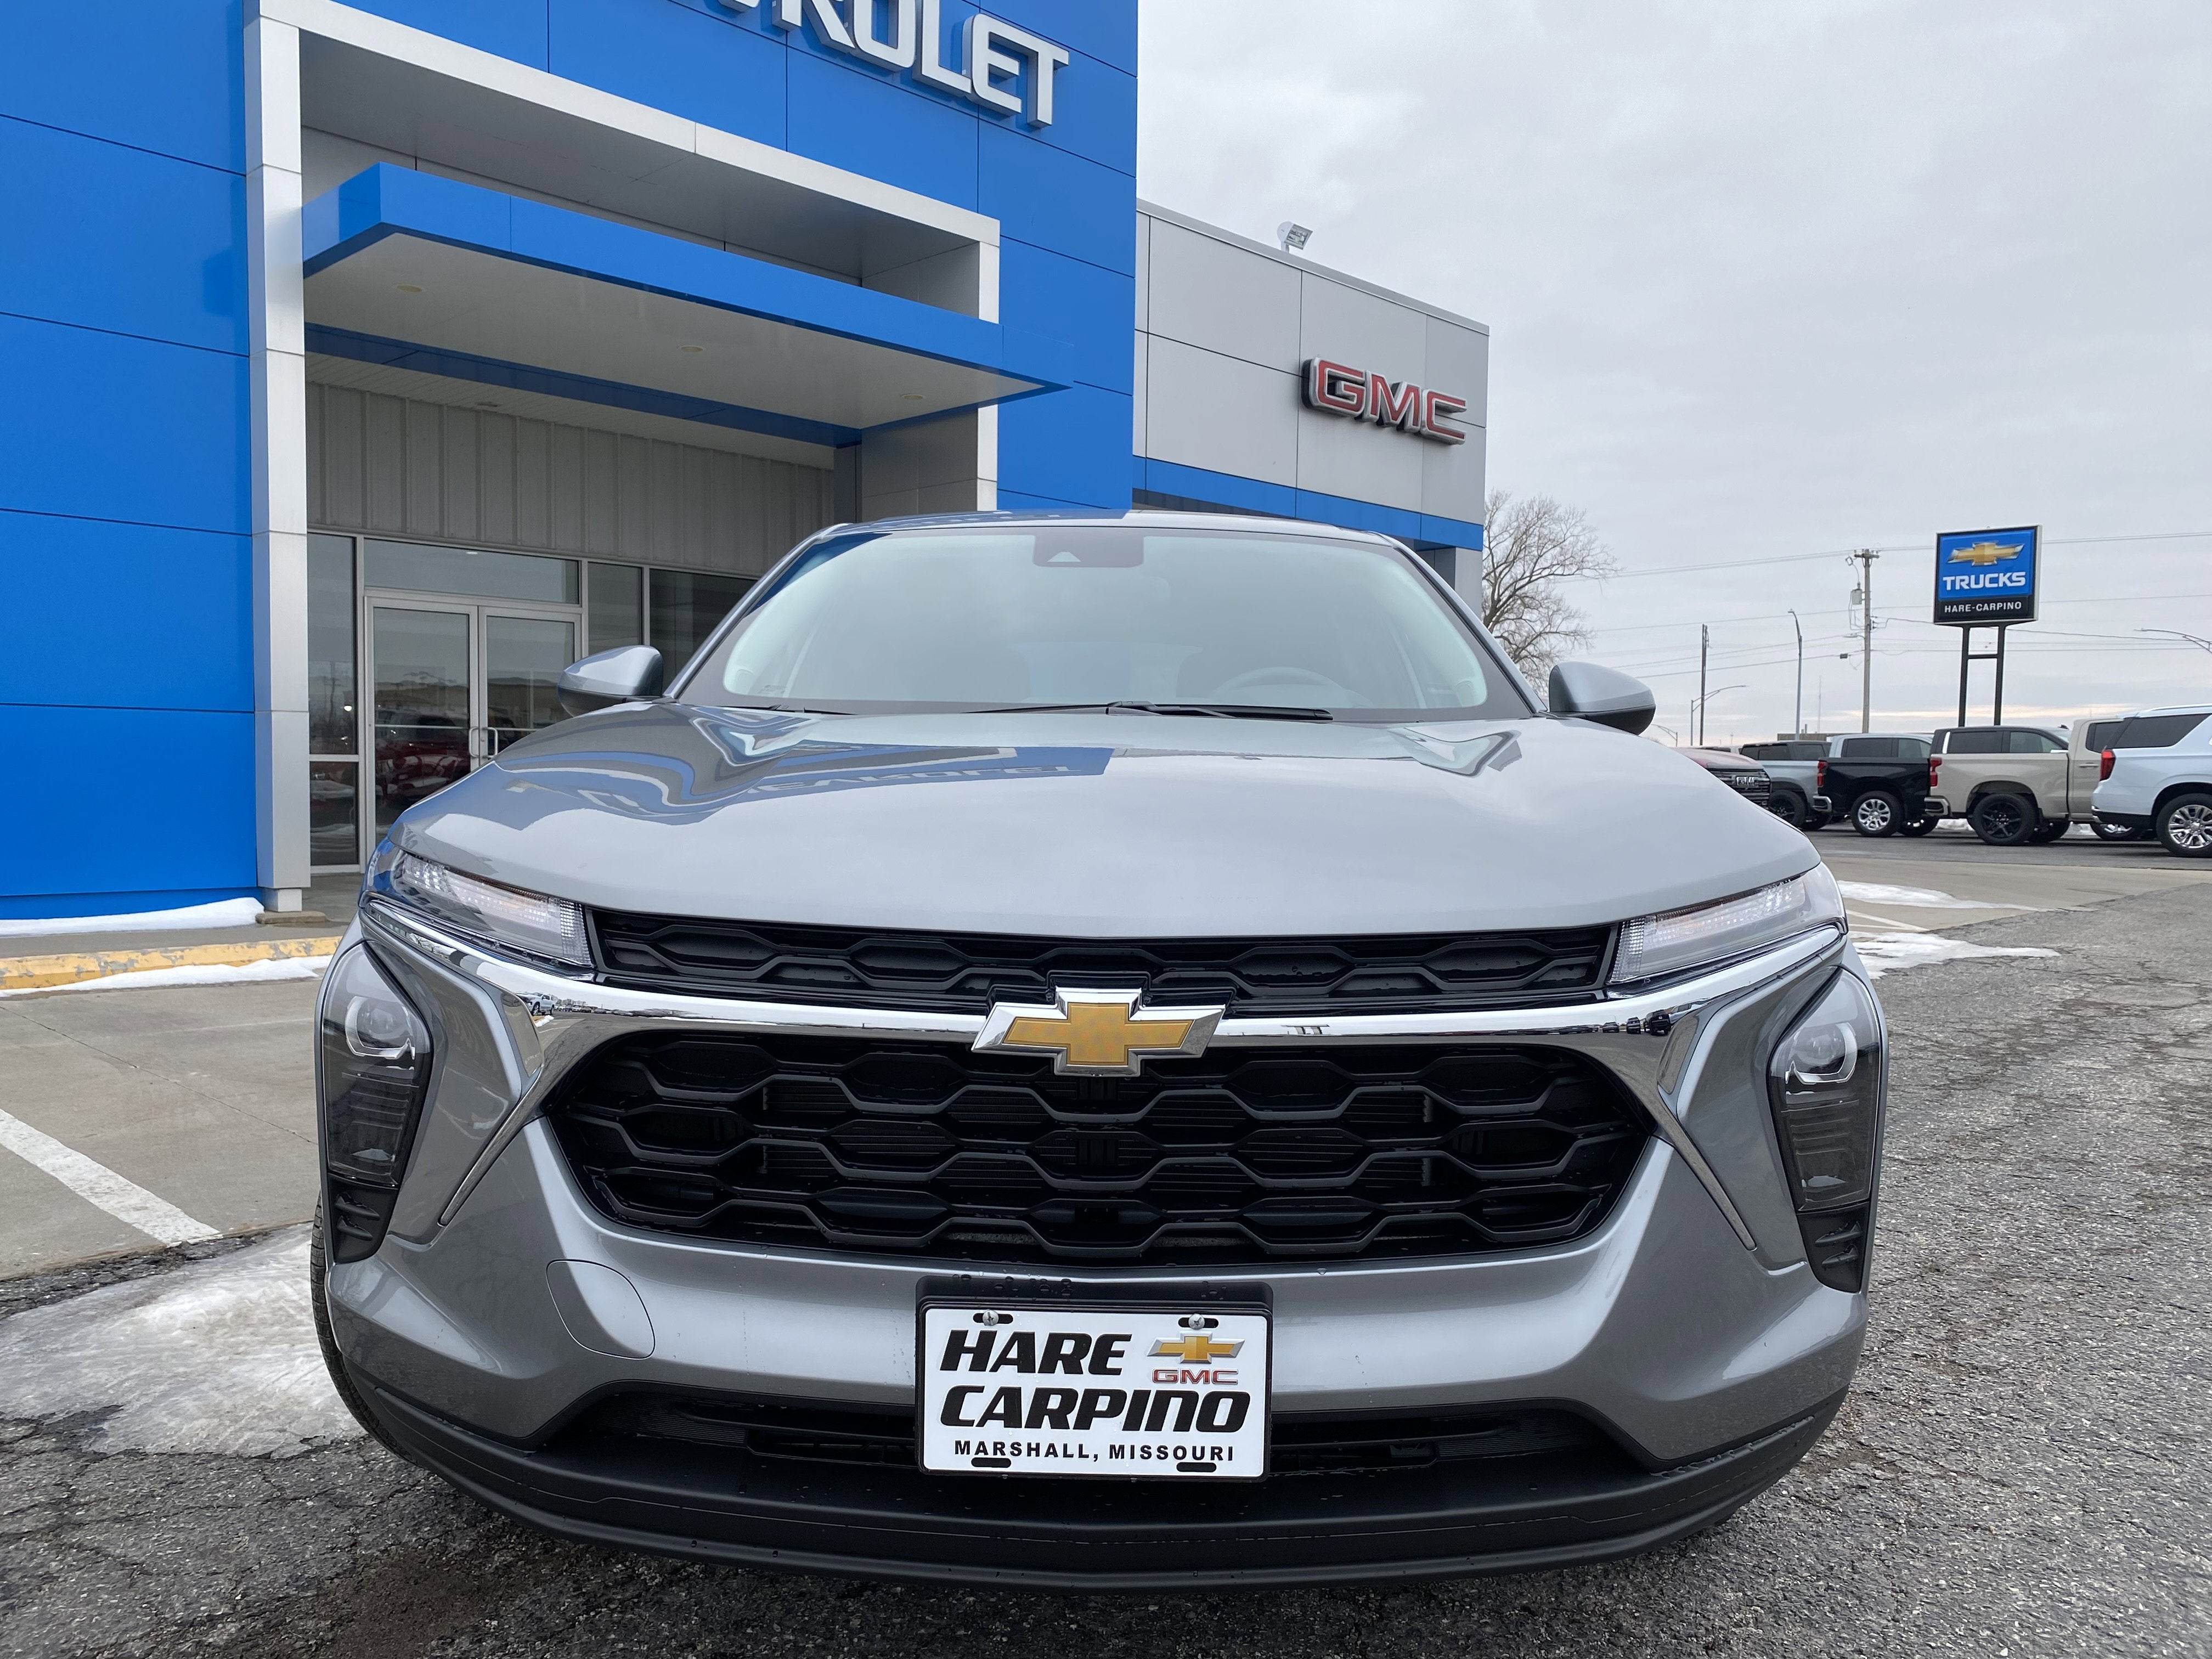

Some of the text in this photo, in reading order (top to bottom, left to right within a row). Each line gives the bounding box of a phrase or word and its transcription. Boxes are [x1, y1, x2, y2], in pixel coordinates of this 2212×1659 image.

[714, 0, 1069, 128] OLET
[1302, 357, 1468, 445] GMC
[1943, 571, 2026, 590] TRUCKS
[1944, 601, 2022, 613] HARE-CARPINO
[940, 1329, 1132, 1375] HARE
[1152, 1368, 1239, 1385] GMC
[940, 1385, 1251, 1432] CARPINO
[954, 1440, 1233, 1462] MARSHALL, MISSOURI
